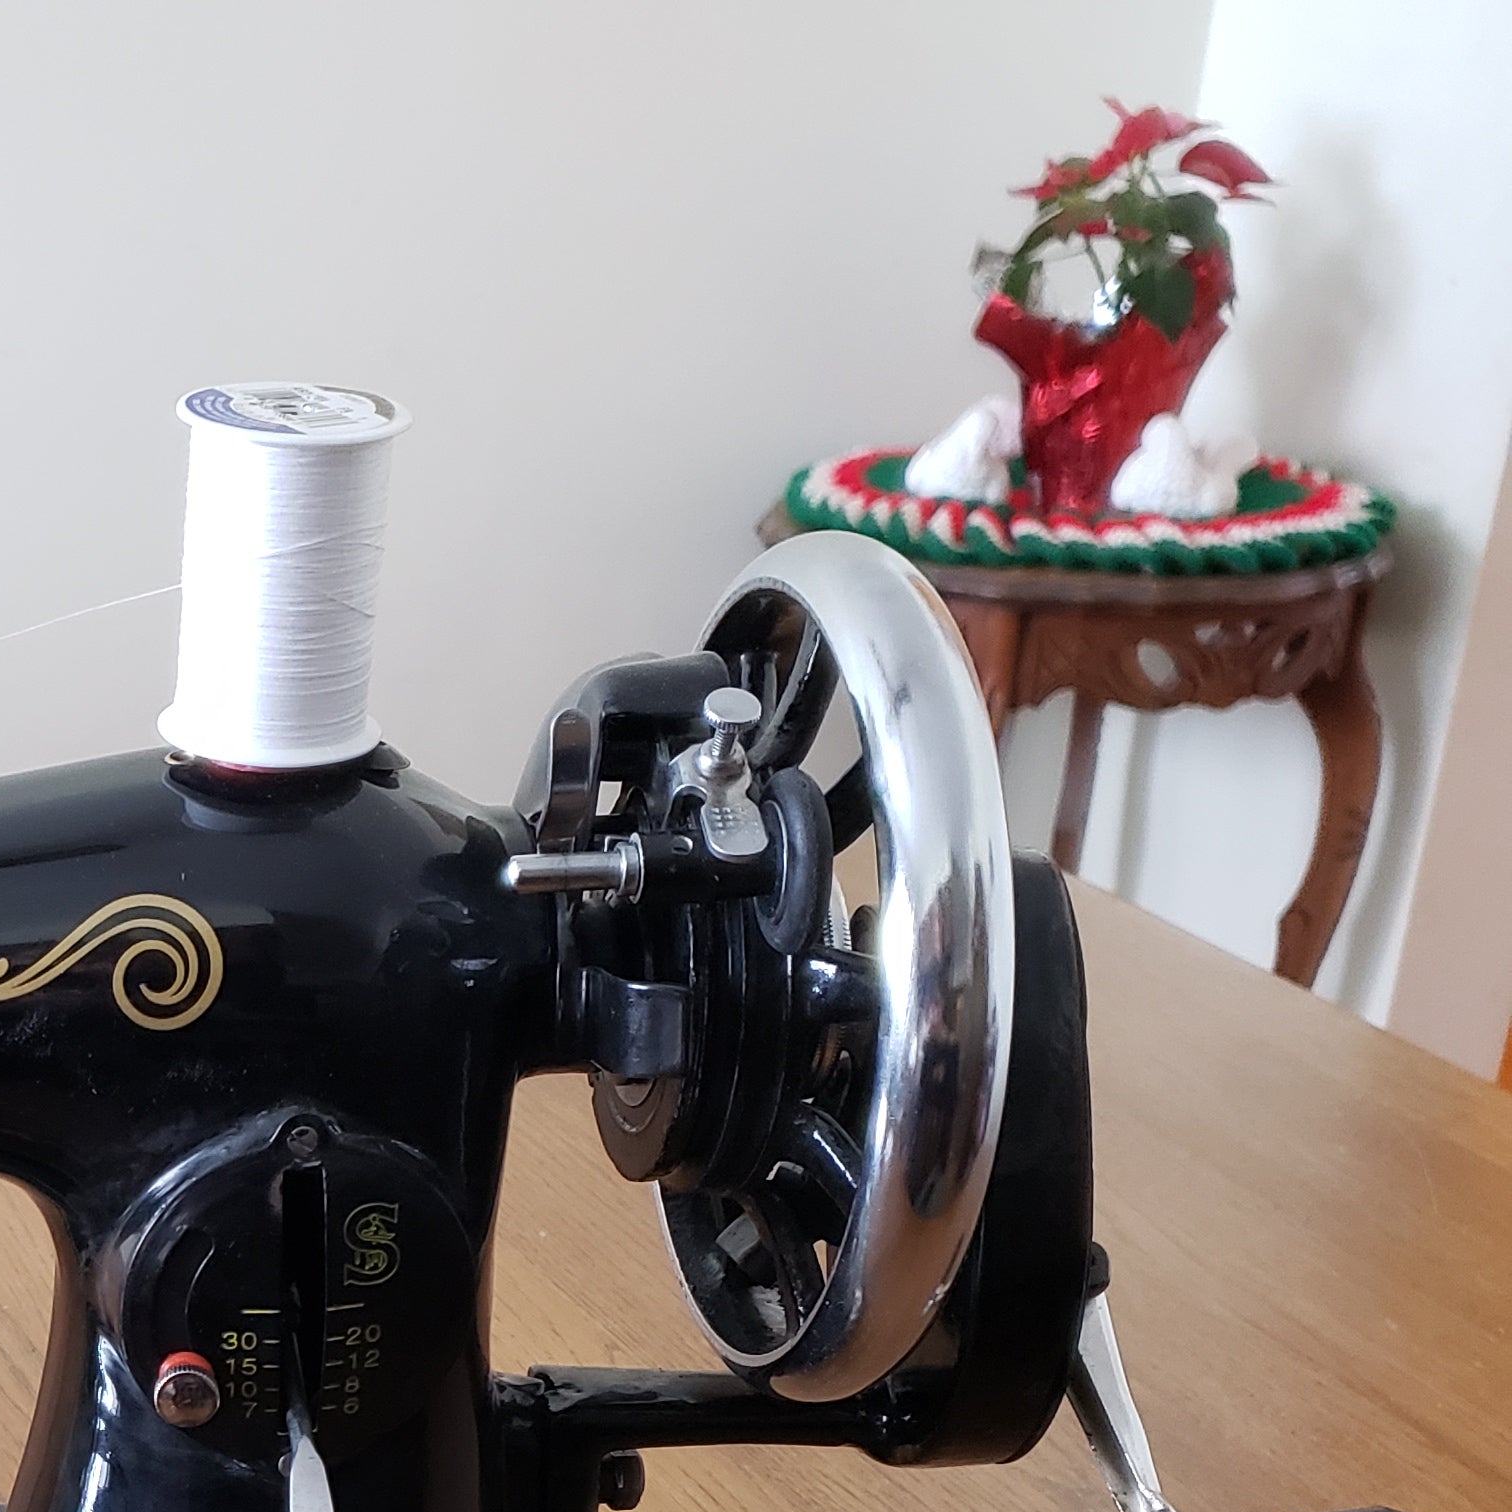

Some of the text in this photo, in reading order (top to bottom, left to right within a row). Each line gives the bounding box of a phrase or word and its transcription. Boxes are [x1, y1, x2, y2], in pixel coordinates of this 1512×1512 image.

[220, 1331, 258, 1351] 30
[345, 1324, 382, 1346] 20
[226, 1357, 258, 1376] 15
[348, 1350, 380, 1369] 12
[226, 1381, 258, 1398] 10
[343, 1377, 360, 1394] 8
[241, 1401, 258, 1418] 7
[342, 1397, 360, 1415] 6
